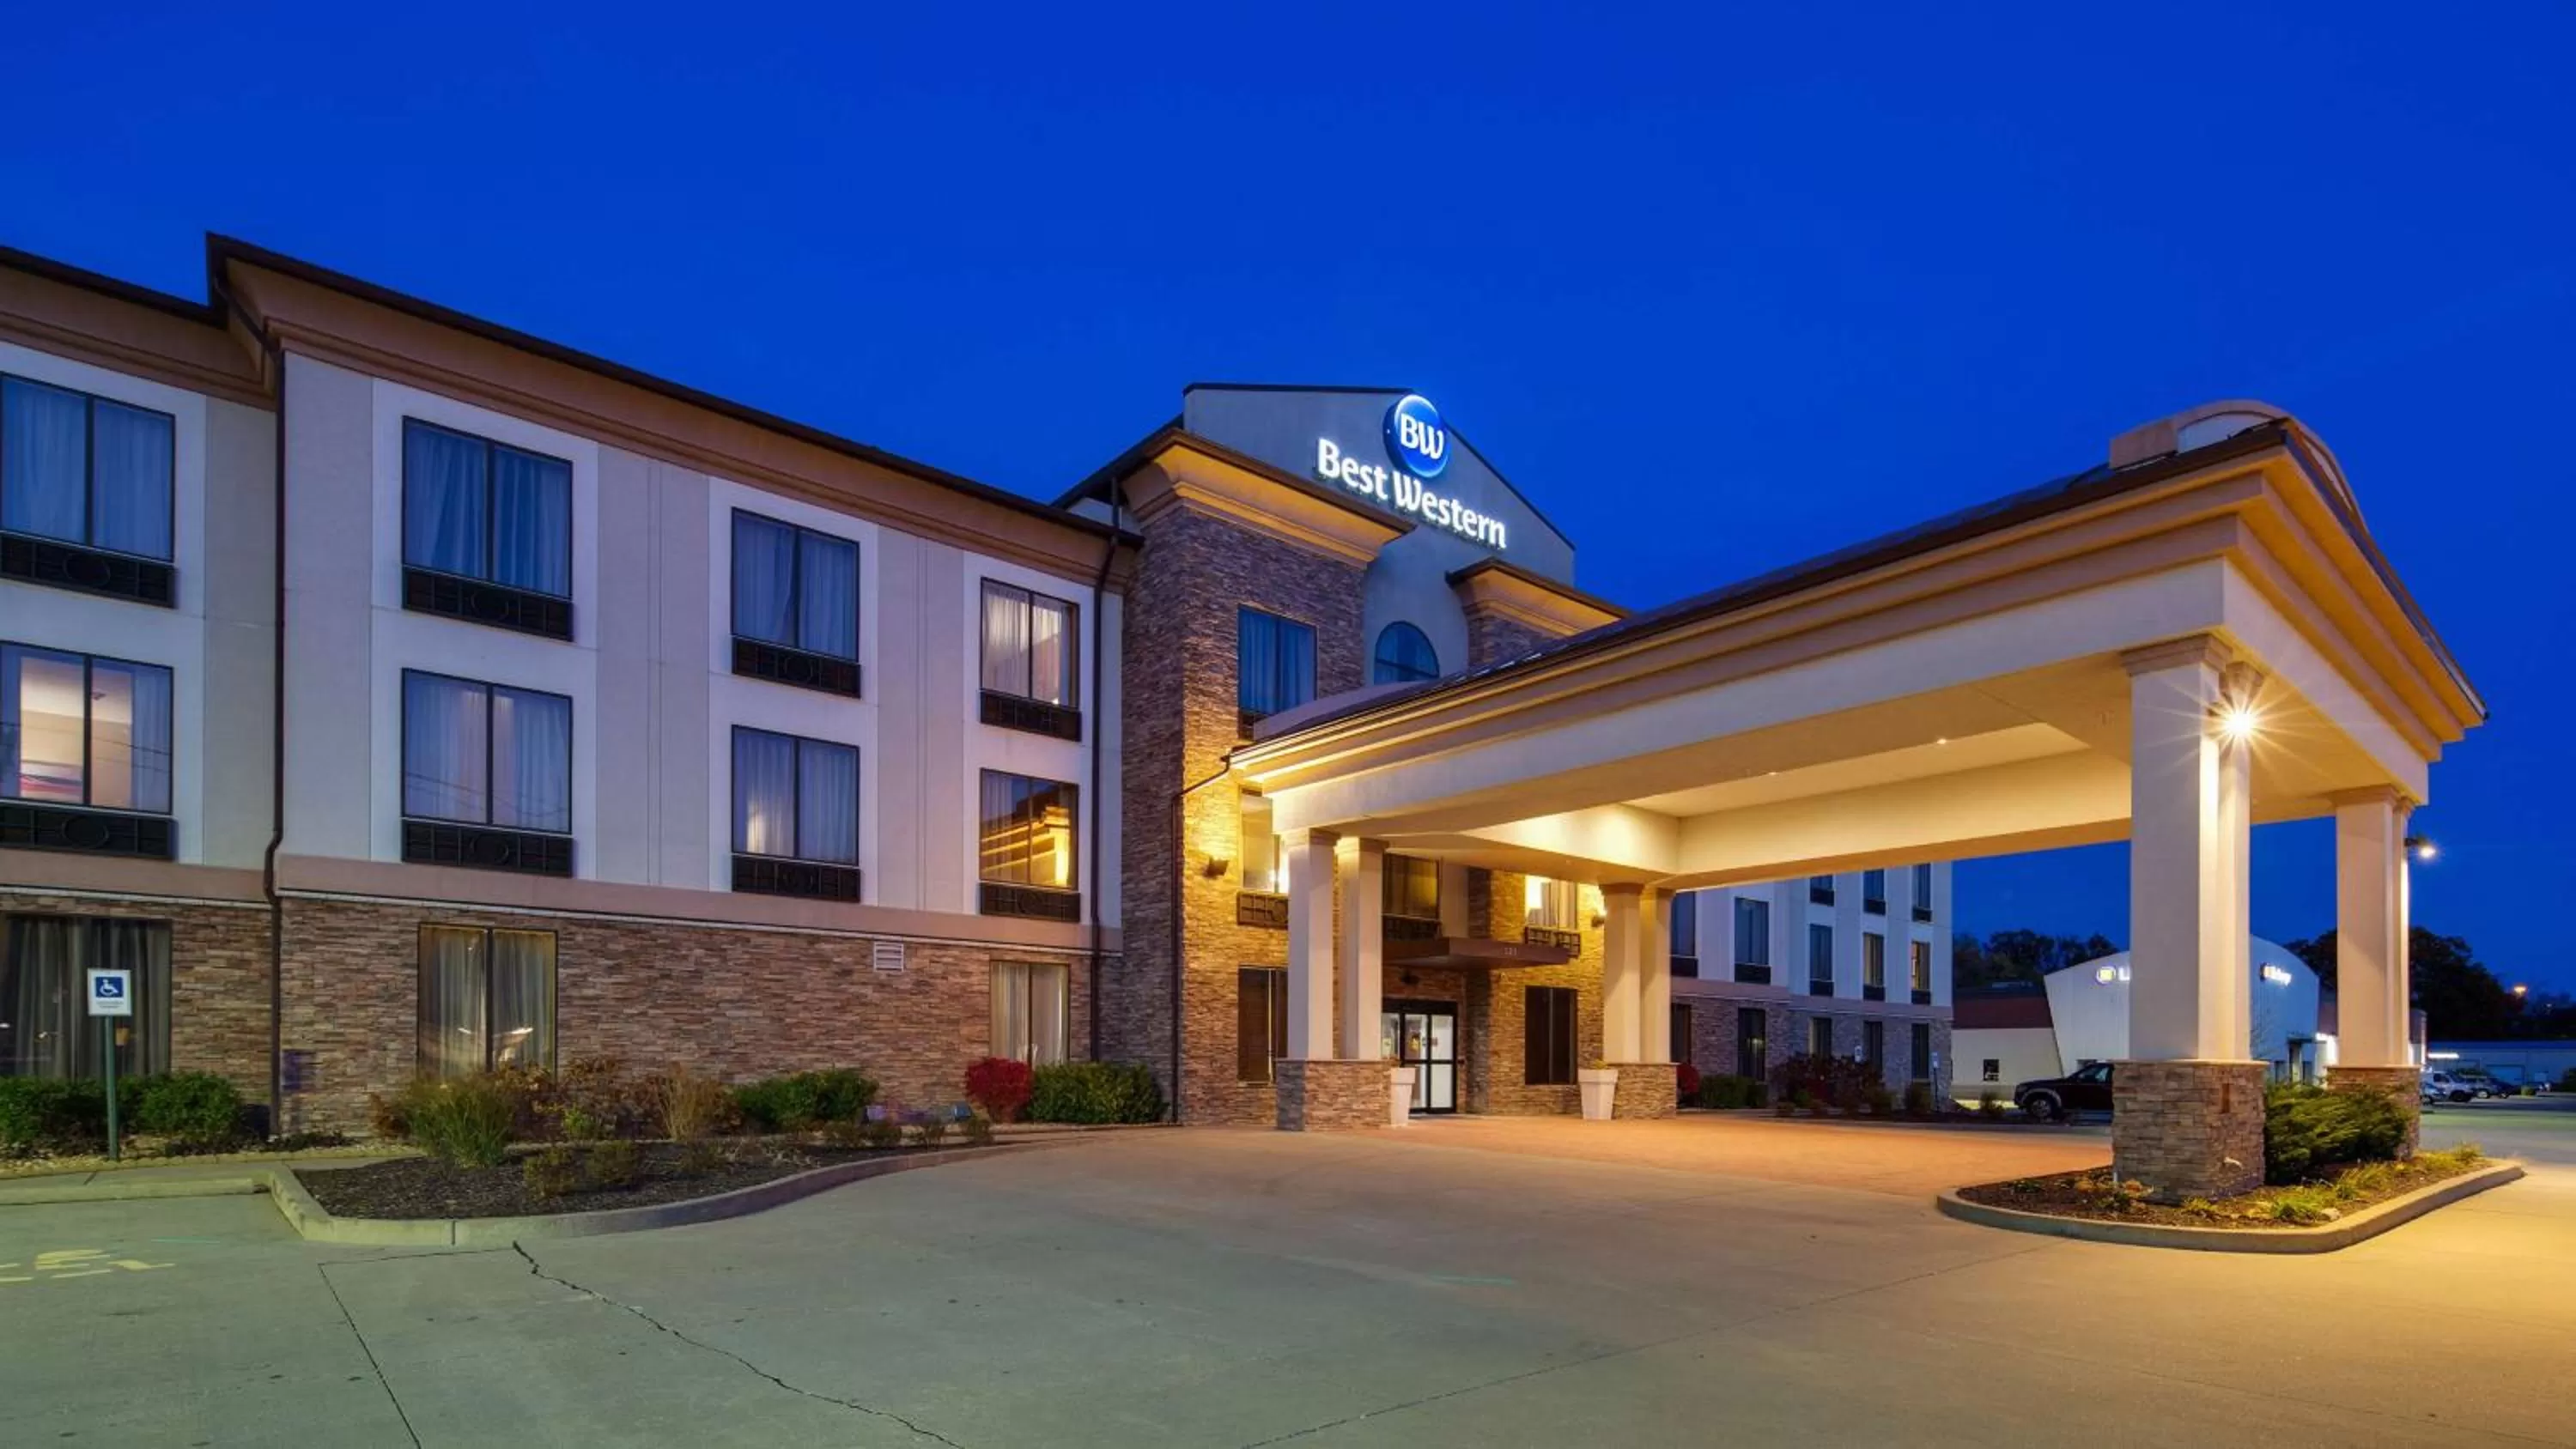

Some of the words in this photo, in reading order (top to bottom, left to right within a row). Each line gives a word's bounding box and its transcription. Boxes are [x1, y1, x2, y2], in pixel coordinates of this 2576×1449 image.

[1400, 413, 1444, 459] BW
[1318, 438, 1388, 500] Best
[1393, 470, 1506, 549] Western
